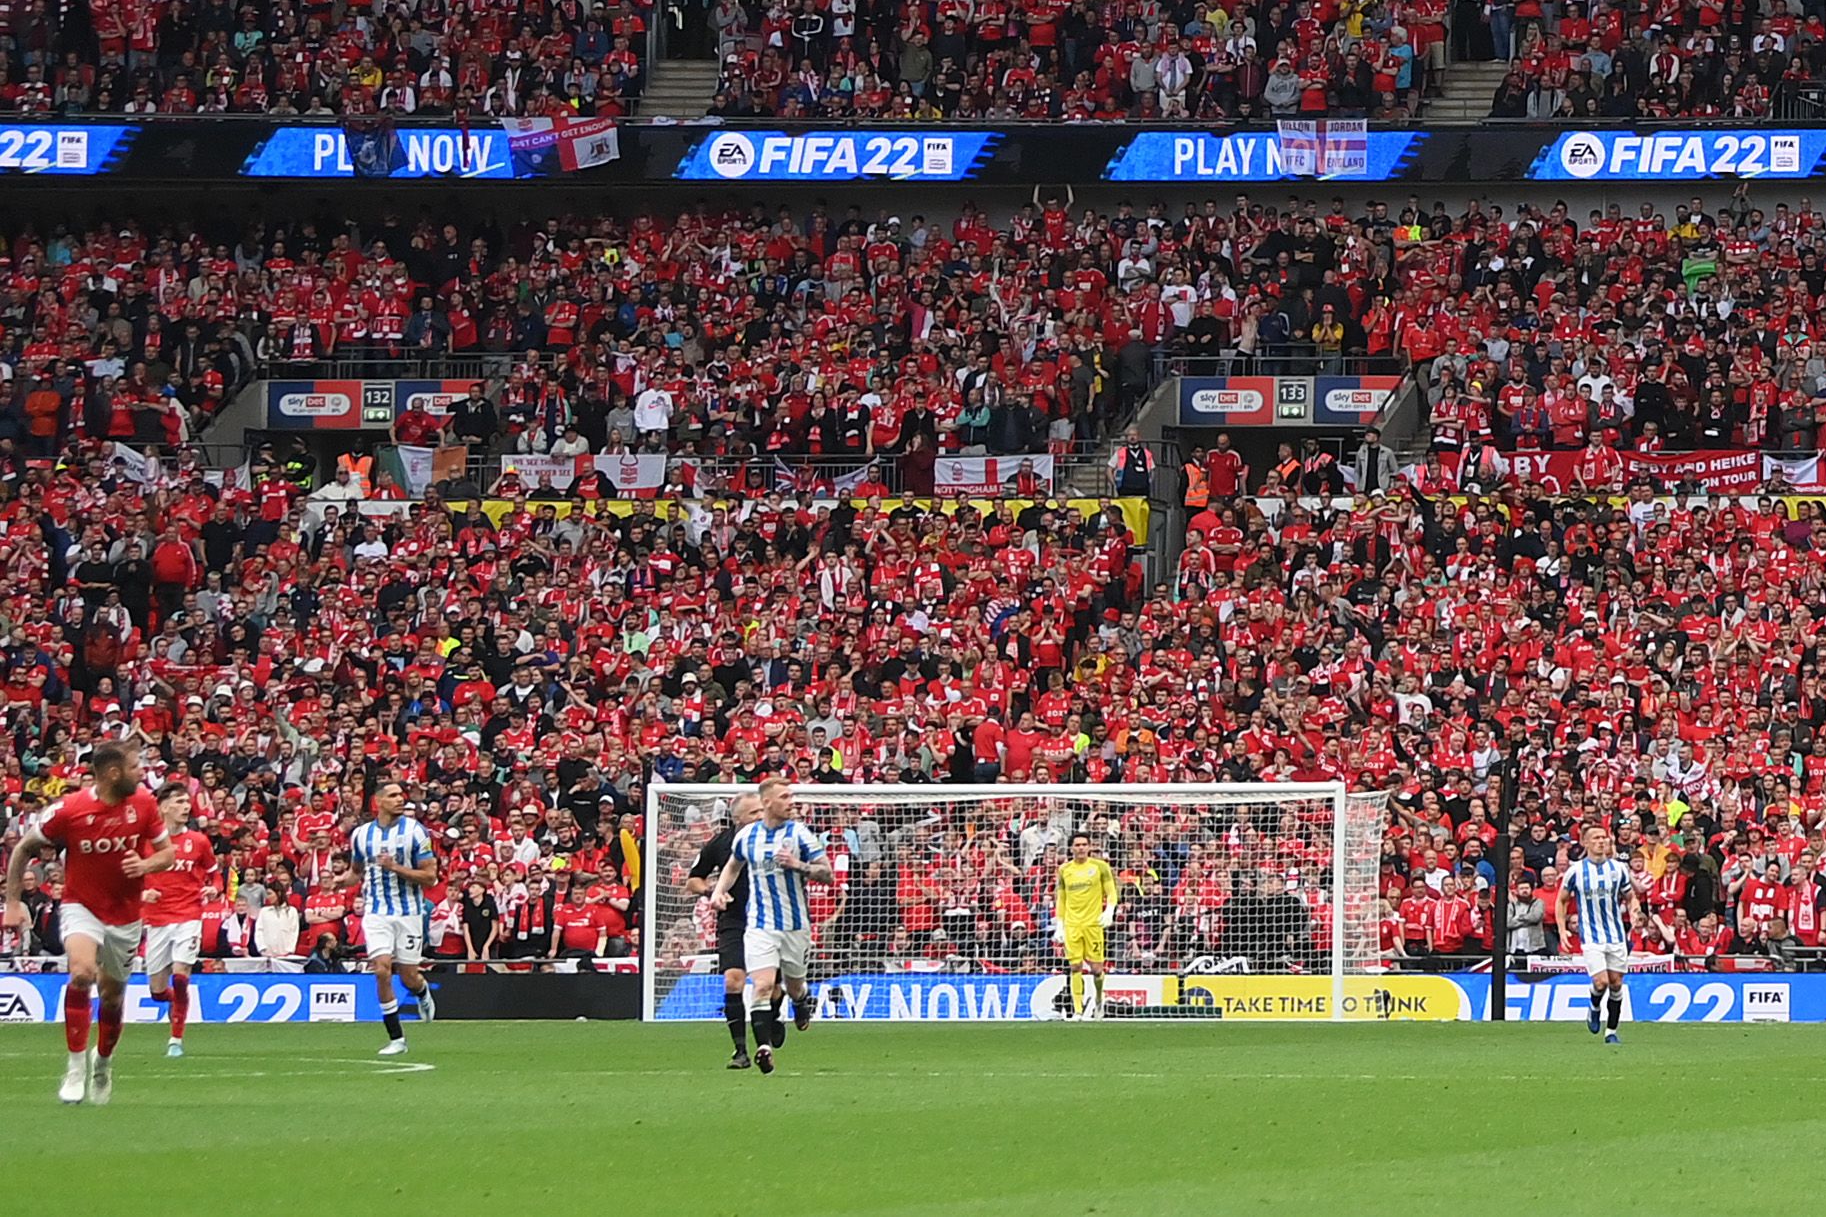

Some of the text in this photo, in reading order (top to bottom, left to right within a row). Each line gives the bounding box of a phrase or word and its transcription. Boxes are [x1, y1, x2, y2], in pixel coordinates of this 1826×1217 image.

[1329, 121, 1363, 132] JORDAN
[0, 130, 53, 167] 22
[1774, 140, 1795, 148] FIFA
[314, 134, 492, 172] PL NOW
[758, 137, 919, 174] FIFA 22
[1174, 138, 1263, 175] PLAY
[1609, 136, 1707, 172] FIFA
[1710, 135, 1767, 172] 22
[365, 391, 390, 404] 132
[434, 396, 452, 405] bet
[1200, 393, 1237, 403] sky bet
[1280, 387, 1305, 400] 133
[1333, 393, 1371, 402] sky bet
[288, 396, 325, 407] sky bet
[1629, 453, 1756, 474] EBY HEIKE
[1722, 471, 1757, 486] TOUR
[934, 485, 998, 495] NOTTINGHAM
[80, 834, 141, 854] BOXT
[405, 935, 422, 951] 37
[217, 983, 302, 1023] 22
[315, 991, 350, 1004] FIFA
[890, 983, 1022, 1020] NOW
[1224, 996, 1273, 1013] TAKE
[1279, 996, 1326, 1013] TIME
[1649, 982, 1735, 1023] 22
[1748, 991, 1782, 1005] FIFA
